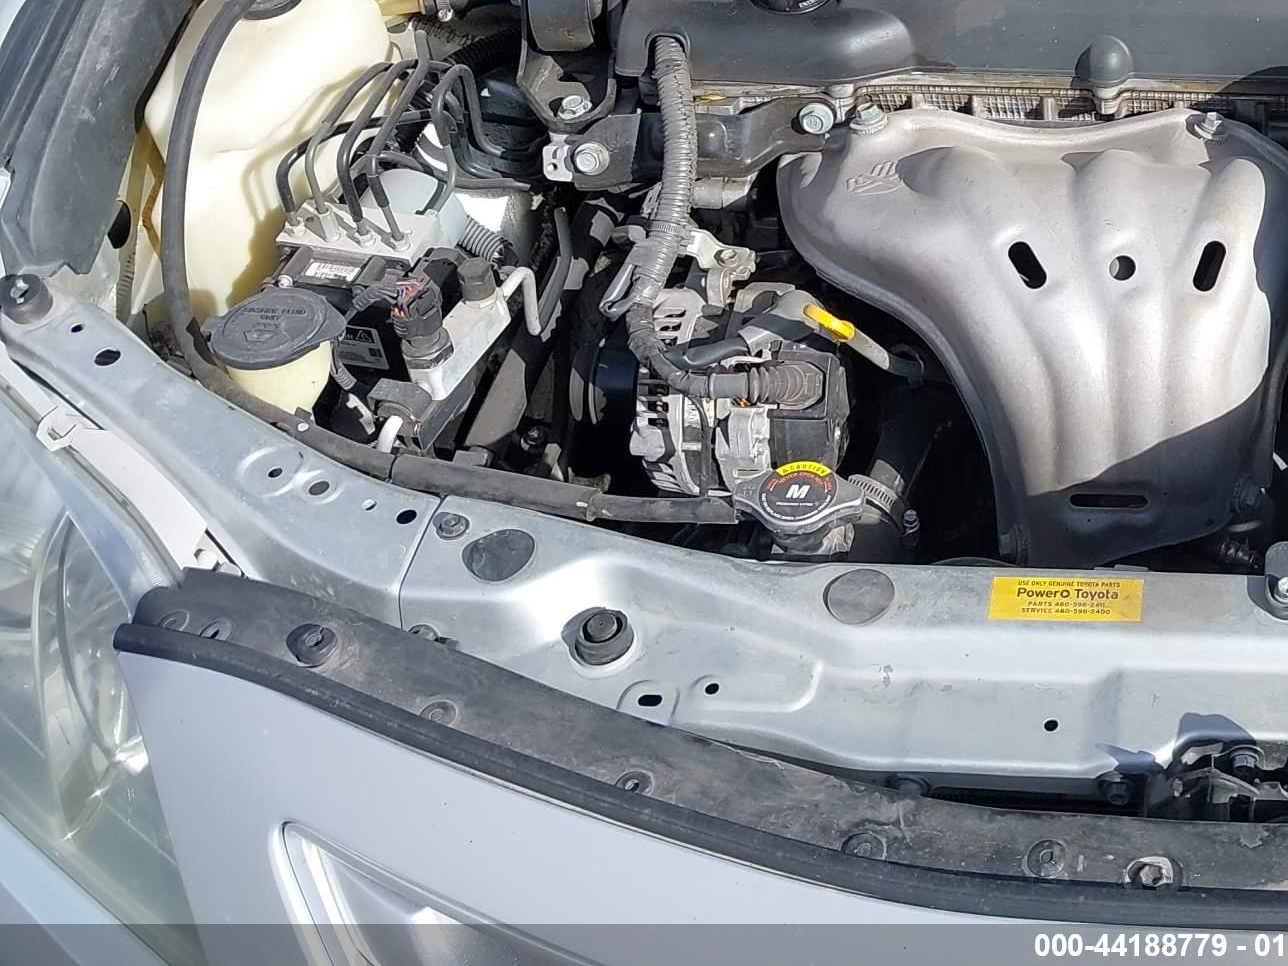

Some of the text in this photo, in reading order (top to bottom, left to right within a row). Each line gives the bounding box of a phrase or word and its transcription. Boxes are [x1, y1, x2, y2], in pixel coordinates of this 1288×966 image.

[790, 464, 826, 474] CAUTION
[785, 484, 811, 499] M
[1074, 588, 1119, 601] Toyota
